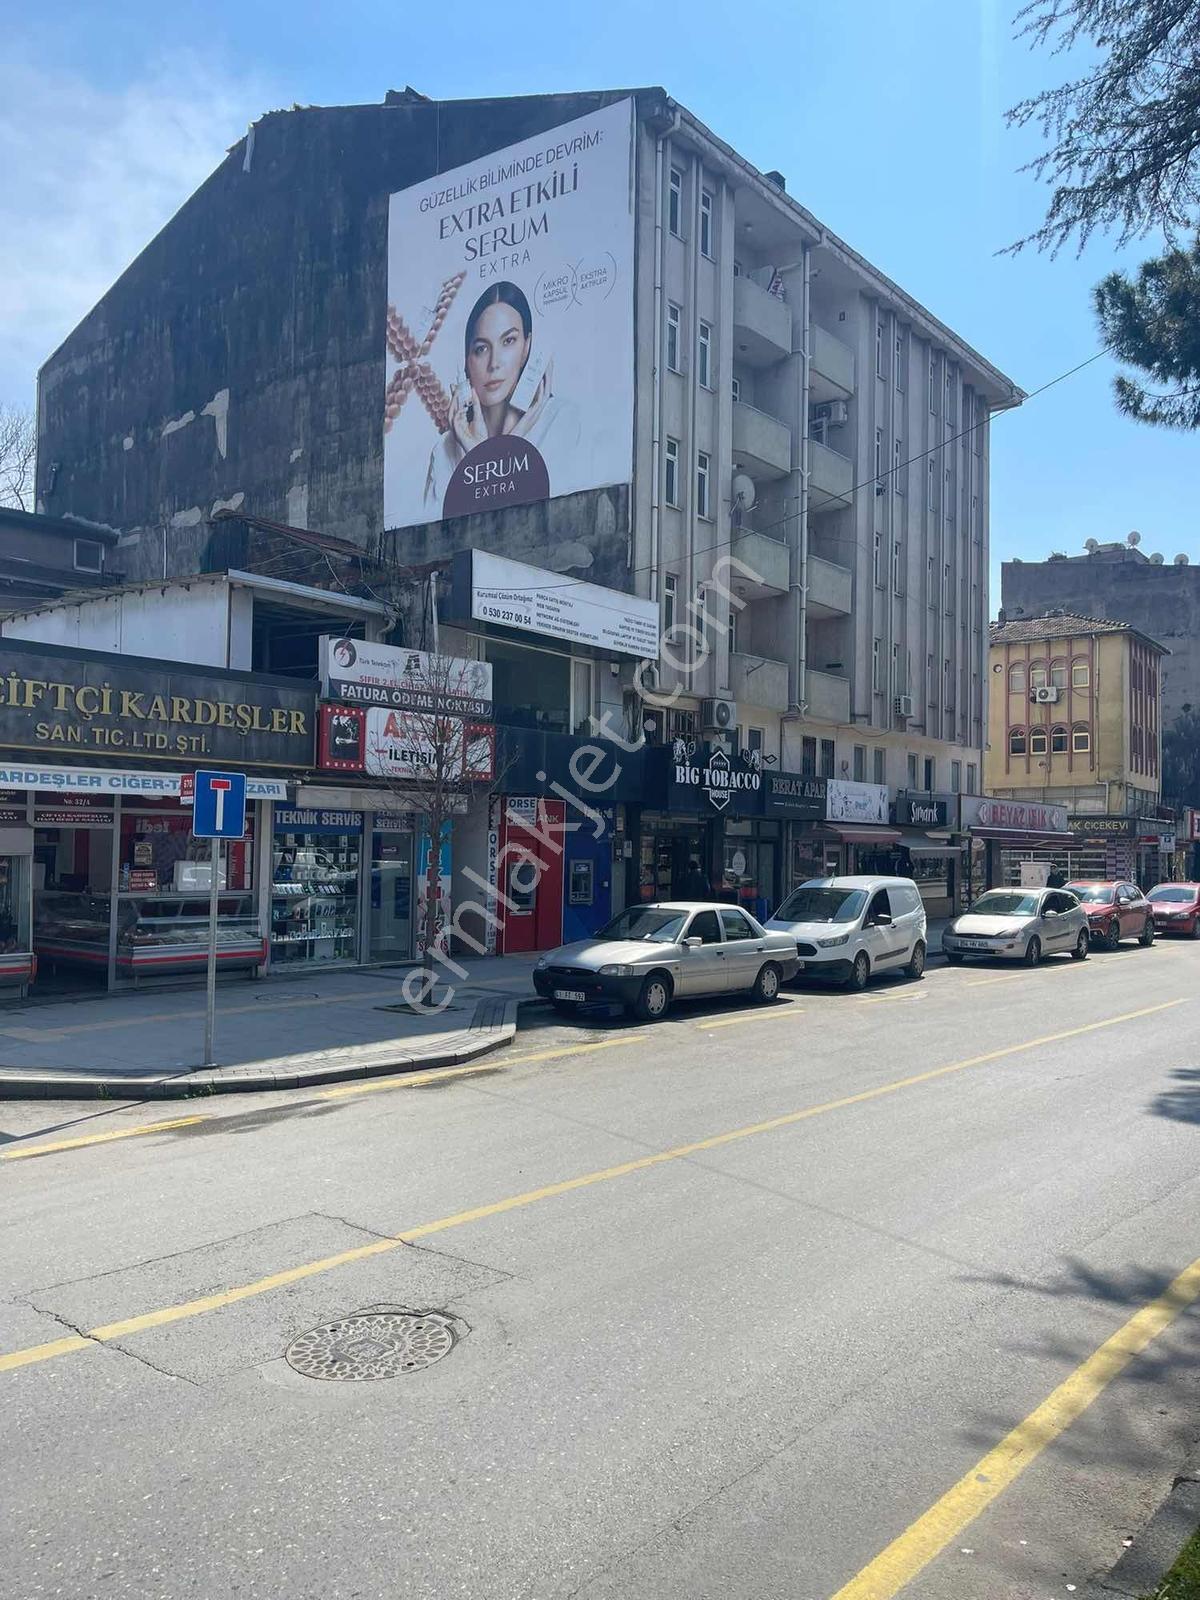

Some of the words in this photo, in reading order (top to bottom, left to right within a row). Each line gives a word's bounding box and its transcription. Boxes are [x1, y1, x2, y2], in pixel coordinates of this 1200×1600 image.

[420, 177, 477, 212] GÜZELLİK
[480, 152, 543, 190] BİLİMİNDE
[546, 130, 603, 165] DEVRİM:
[439, 198, 505, 240] EXTRA
[510, 162, 578, 213] ETKİLİ
[464, 213, 549, 262] SERUM
[480, 249, 531, 278] EXTRA
[464, 453, 529, 486] SERUM
[475, 480, 516, 499] EXTRA
[483, 606, 488, 616] 0
[488, 607, 501, 618] 530
[502, 610, 514, 621] 237
[515, 613, 523, 624] 00
[524, 615, 531, 625] 54
[0, 671, 112, 720] İFTÇİ
[120, 690, 308, 736] KARDEŞLER
[341, 684, 389, 702] FATURA
[36, 722, 88, 744] SAN.
[176, 734, 211, 755] ŞTİ.
[675, 760, 700, 784] BİG
[703, 768, 760, 791] TOBACCO
[772, 778, 803, 797] BERAT
[509, 799, 536, 809] ORSE
[711, 789, 728, 799] HOUSE
[275, 809, 318, 825] TEKNİK
[321, 811, 361, 827] SERVİS
[991, 804, 1025, 826] BEYAZ
